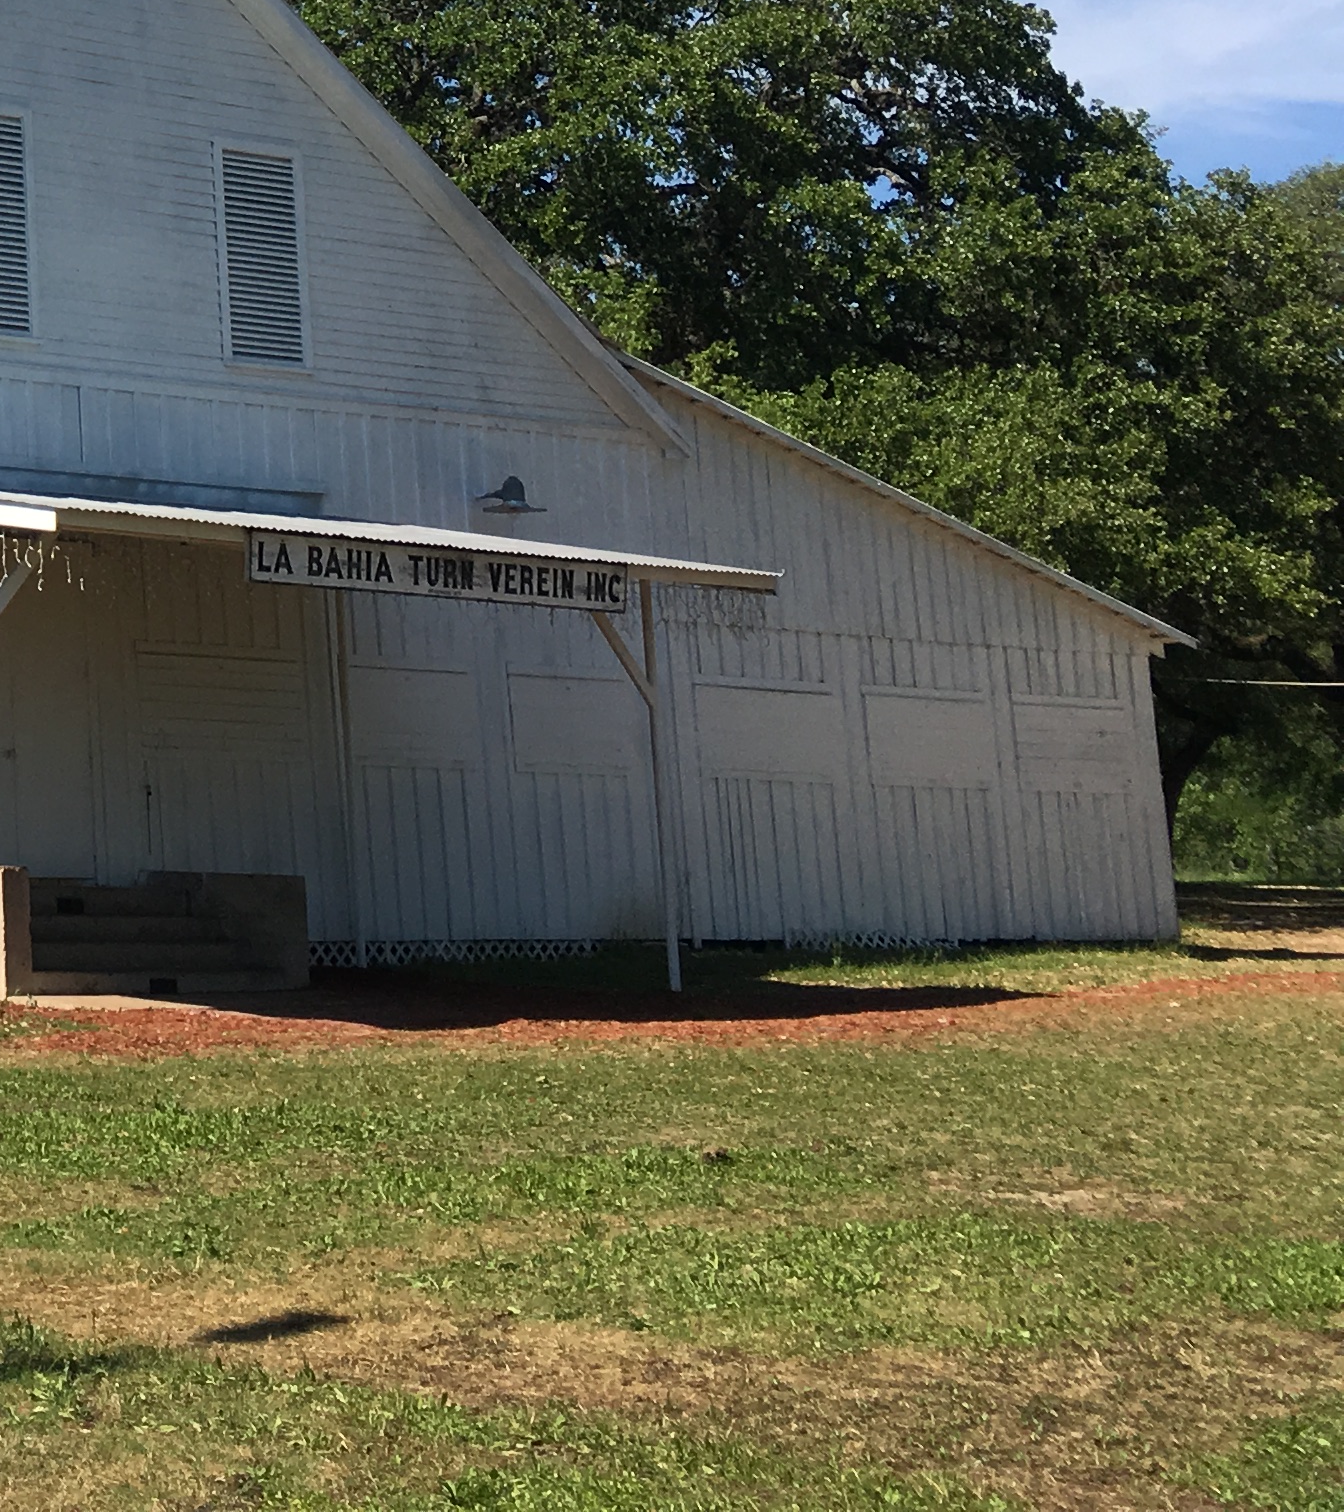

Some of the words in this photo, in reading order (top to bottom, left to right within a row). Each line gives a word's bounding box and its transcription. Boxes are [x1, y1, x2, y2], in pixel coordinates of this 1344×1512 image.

[257, 541, 294, 575] LA
[307, 545, 394, 583] BAHIA
[408, 554, 474, 590] TURN
[488, 562, 575, 599] VEREIN
